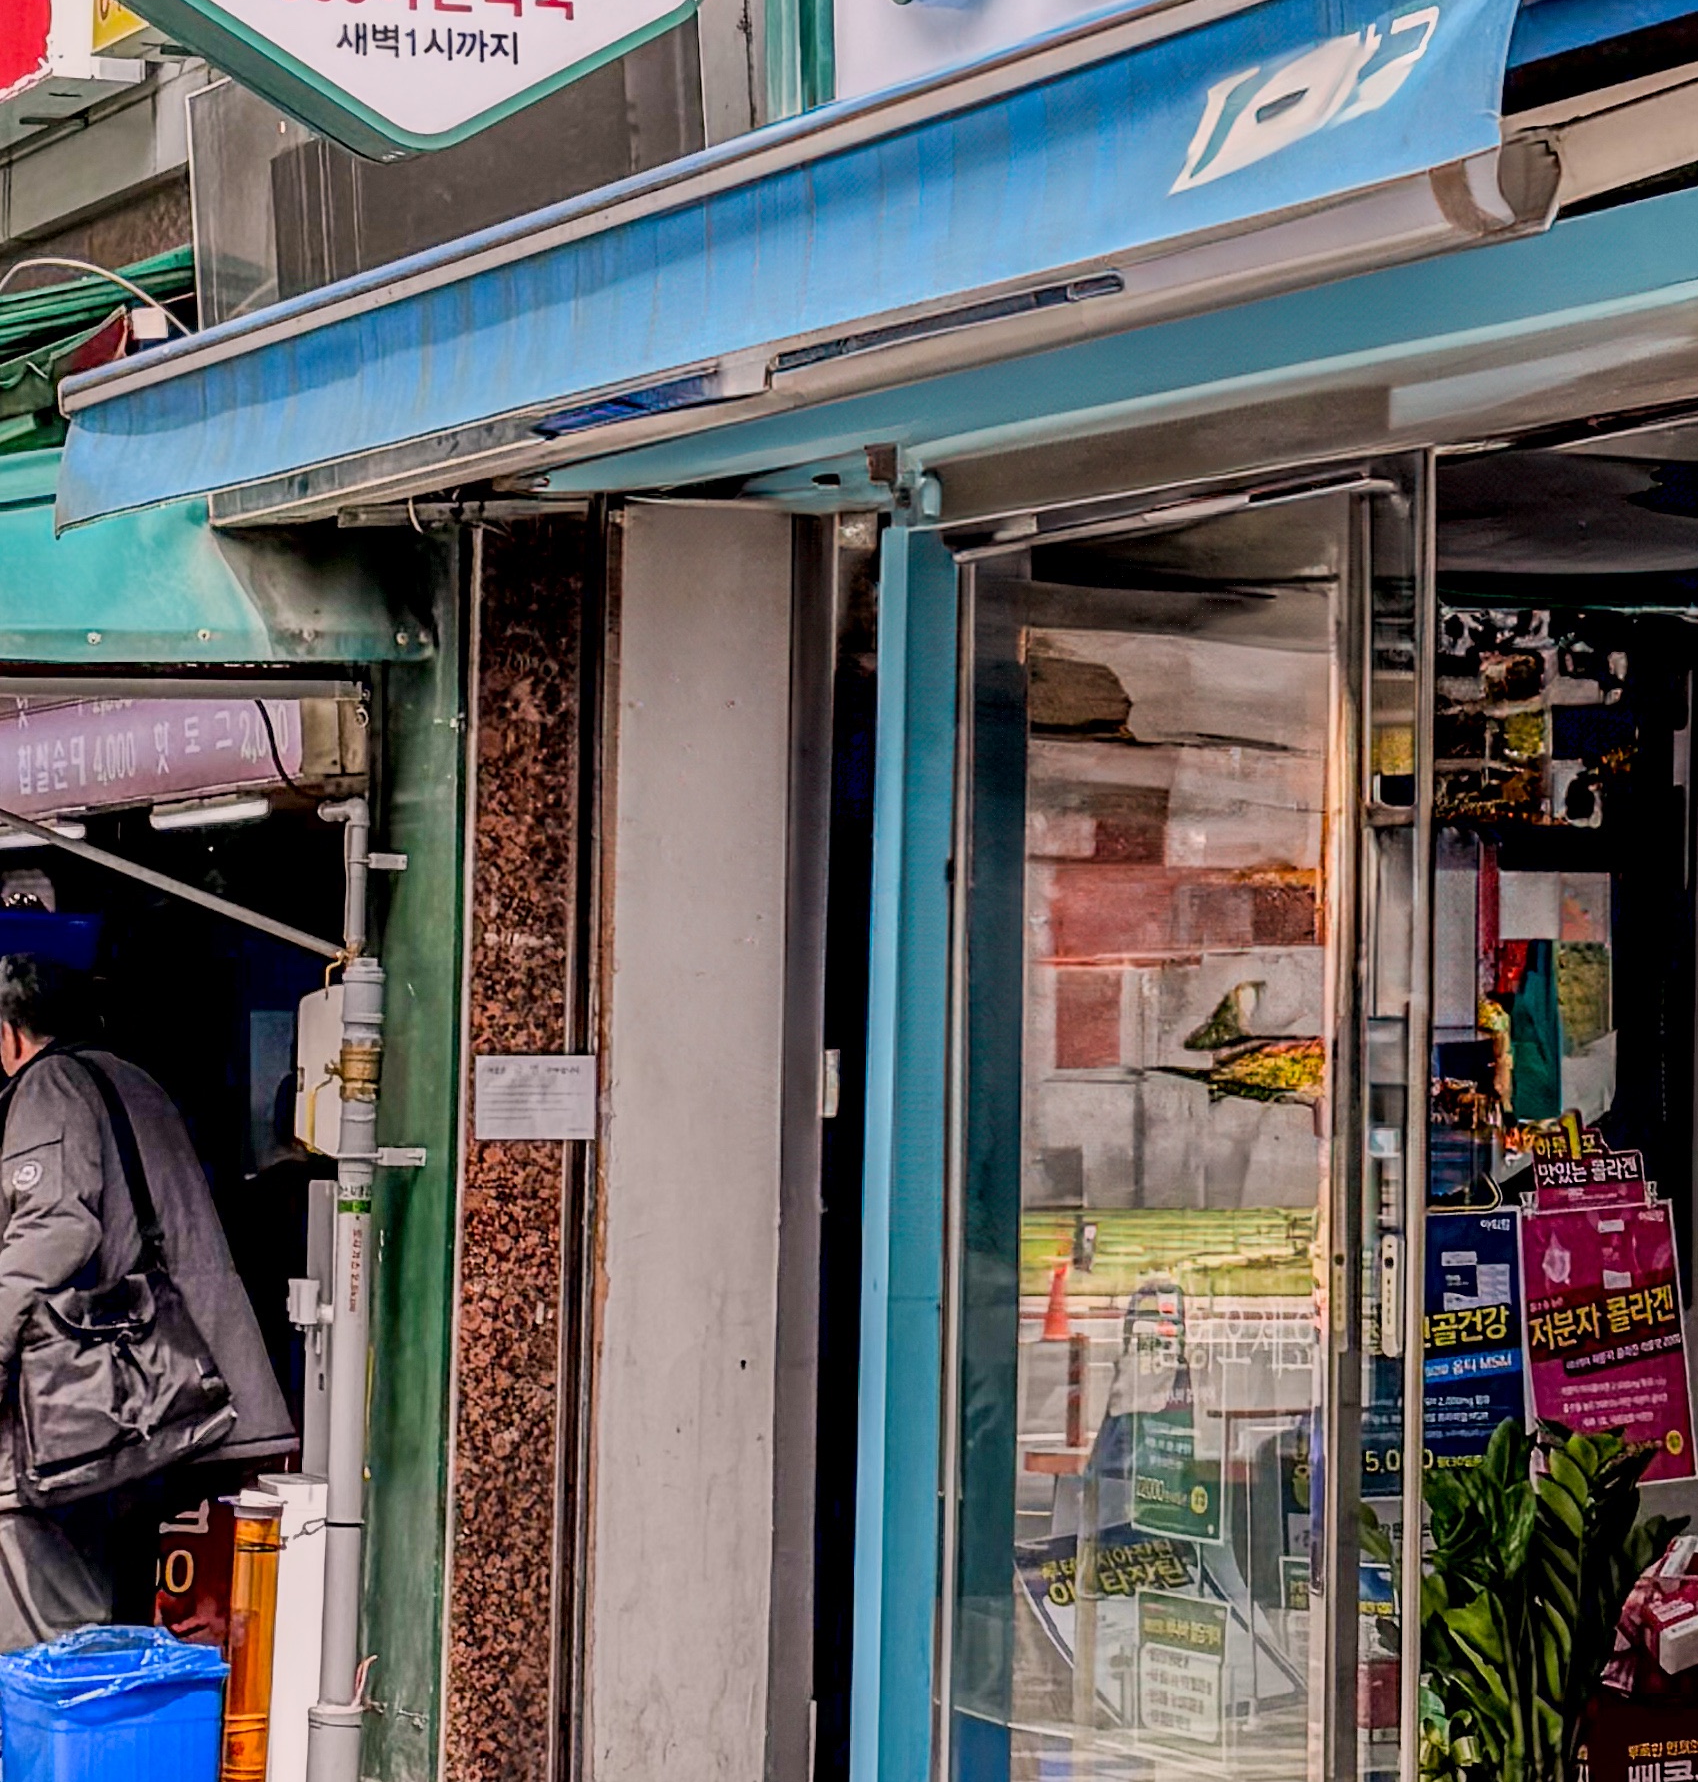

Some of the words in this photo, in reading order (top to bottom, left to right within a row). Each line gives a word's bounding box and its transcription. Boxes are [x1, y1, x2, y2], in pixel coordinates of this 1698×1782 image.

[1537, 1160, 1587, 1186] 맛있는
[1528, 1303, 1603, 1350] 저분자
[1606, 1284, 1676, 1333] 콜라겐
